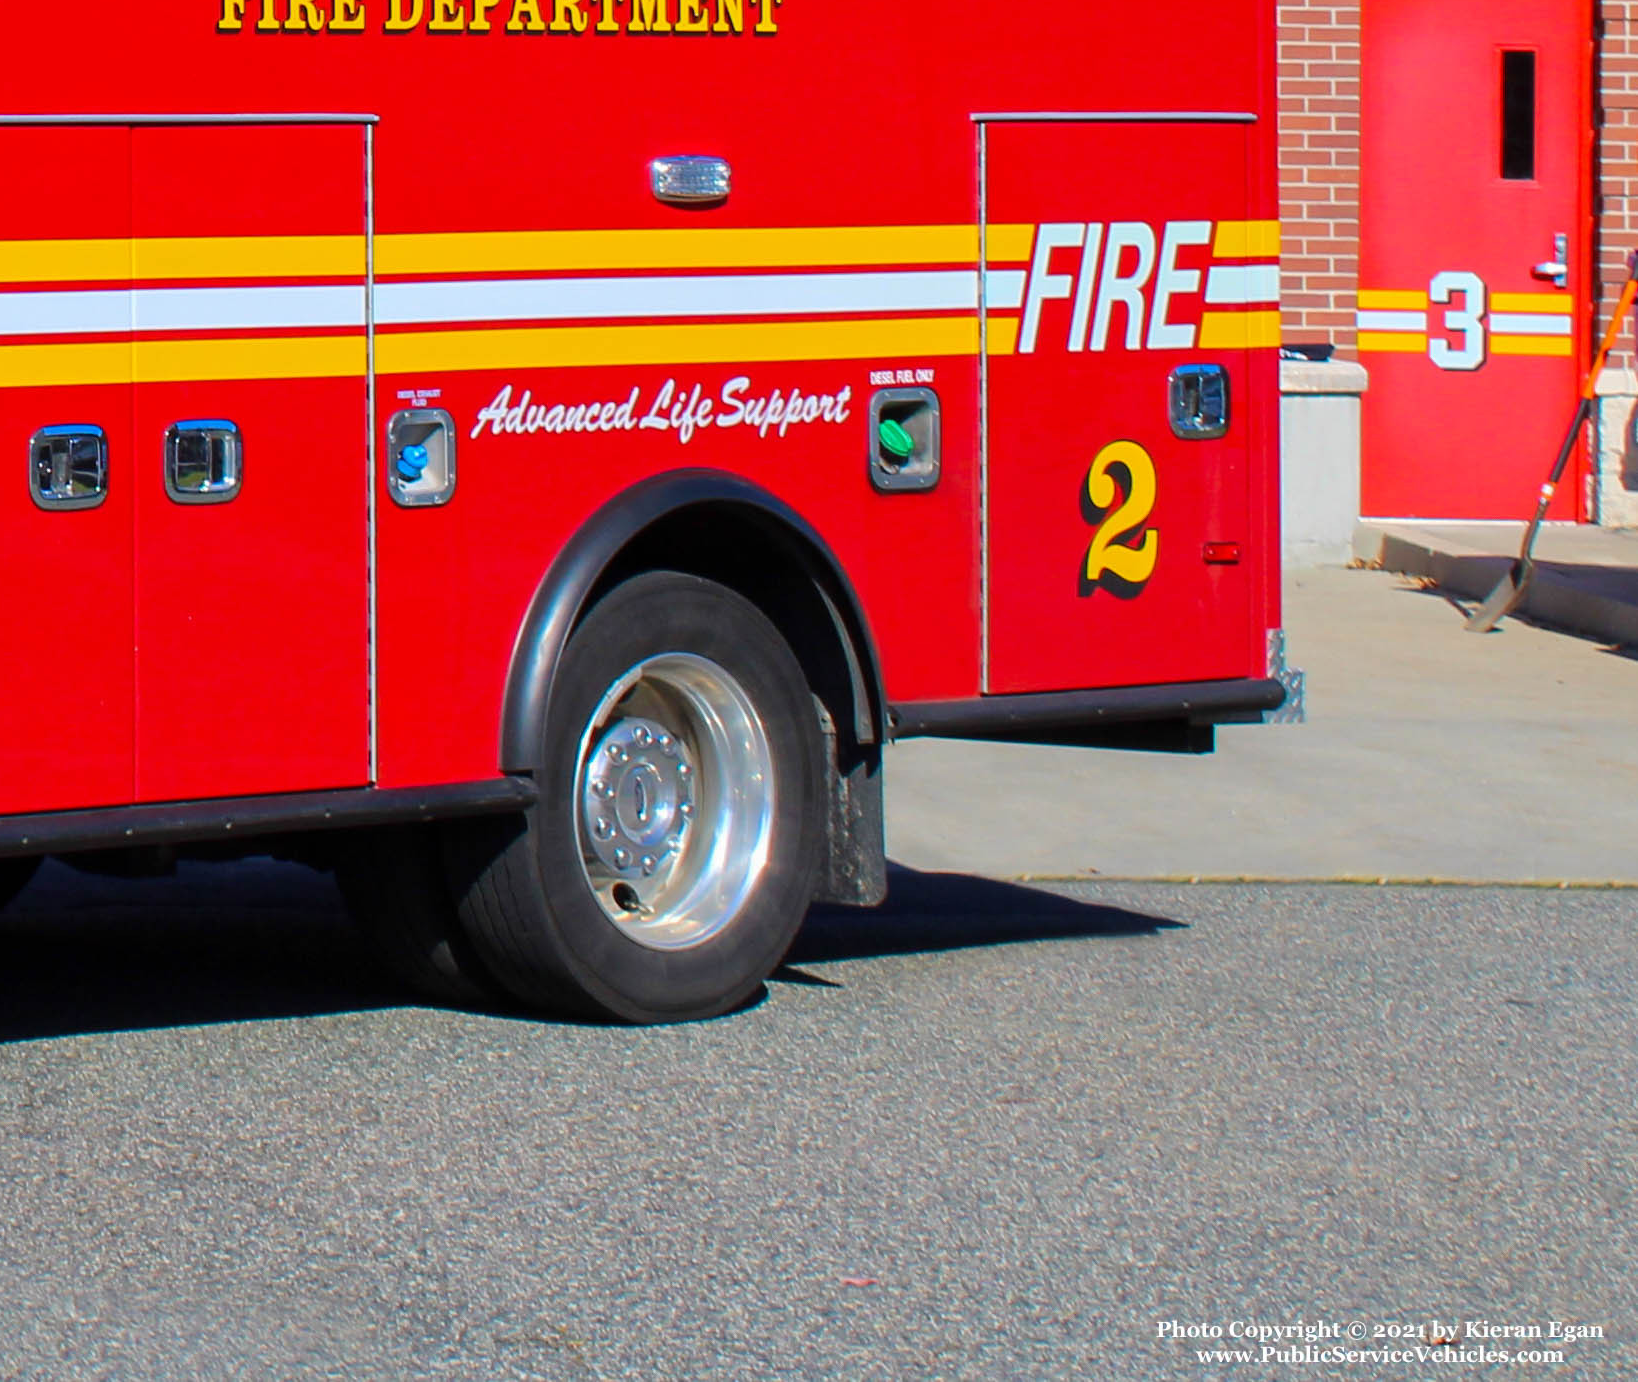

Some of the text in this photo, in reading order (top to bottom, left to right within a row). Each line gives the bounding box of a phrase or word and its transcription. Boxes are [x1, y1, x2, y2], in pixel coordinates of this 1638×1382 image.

[1018, 220, 1213, 354] FIRE
[1429, 271, 1485, 370] 3
[470, 376, 851, 444] Advanced Life Support
[1087, 441, 1159, 584] 2
